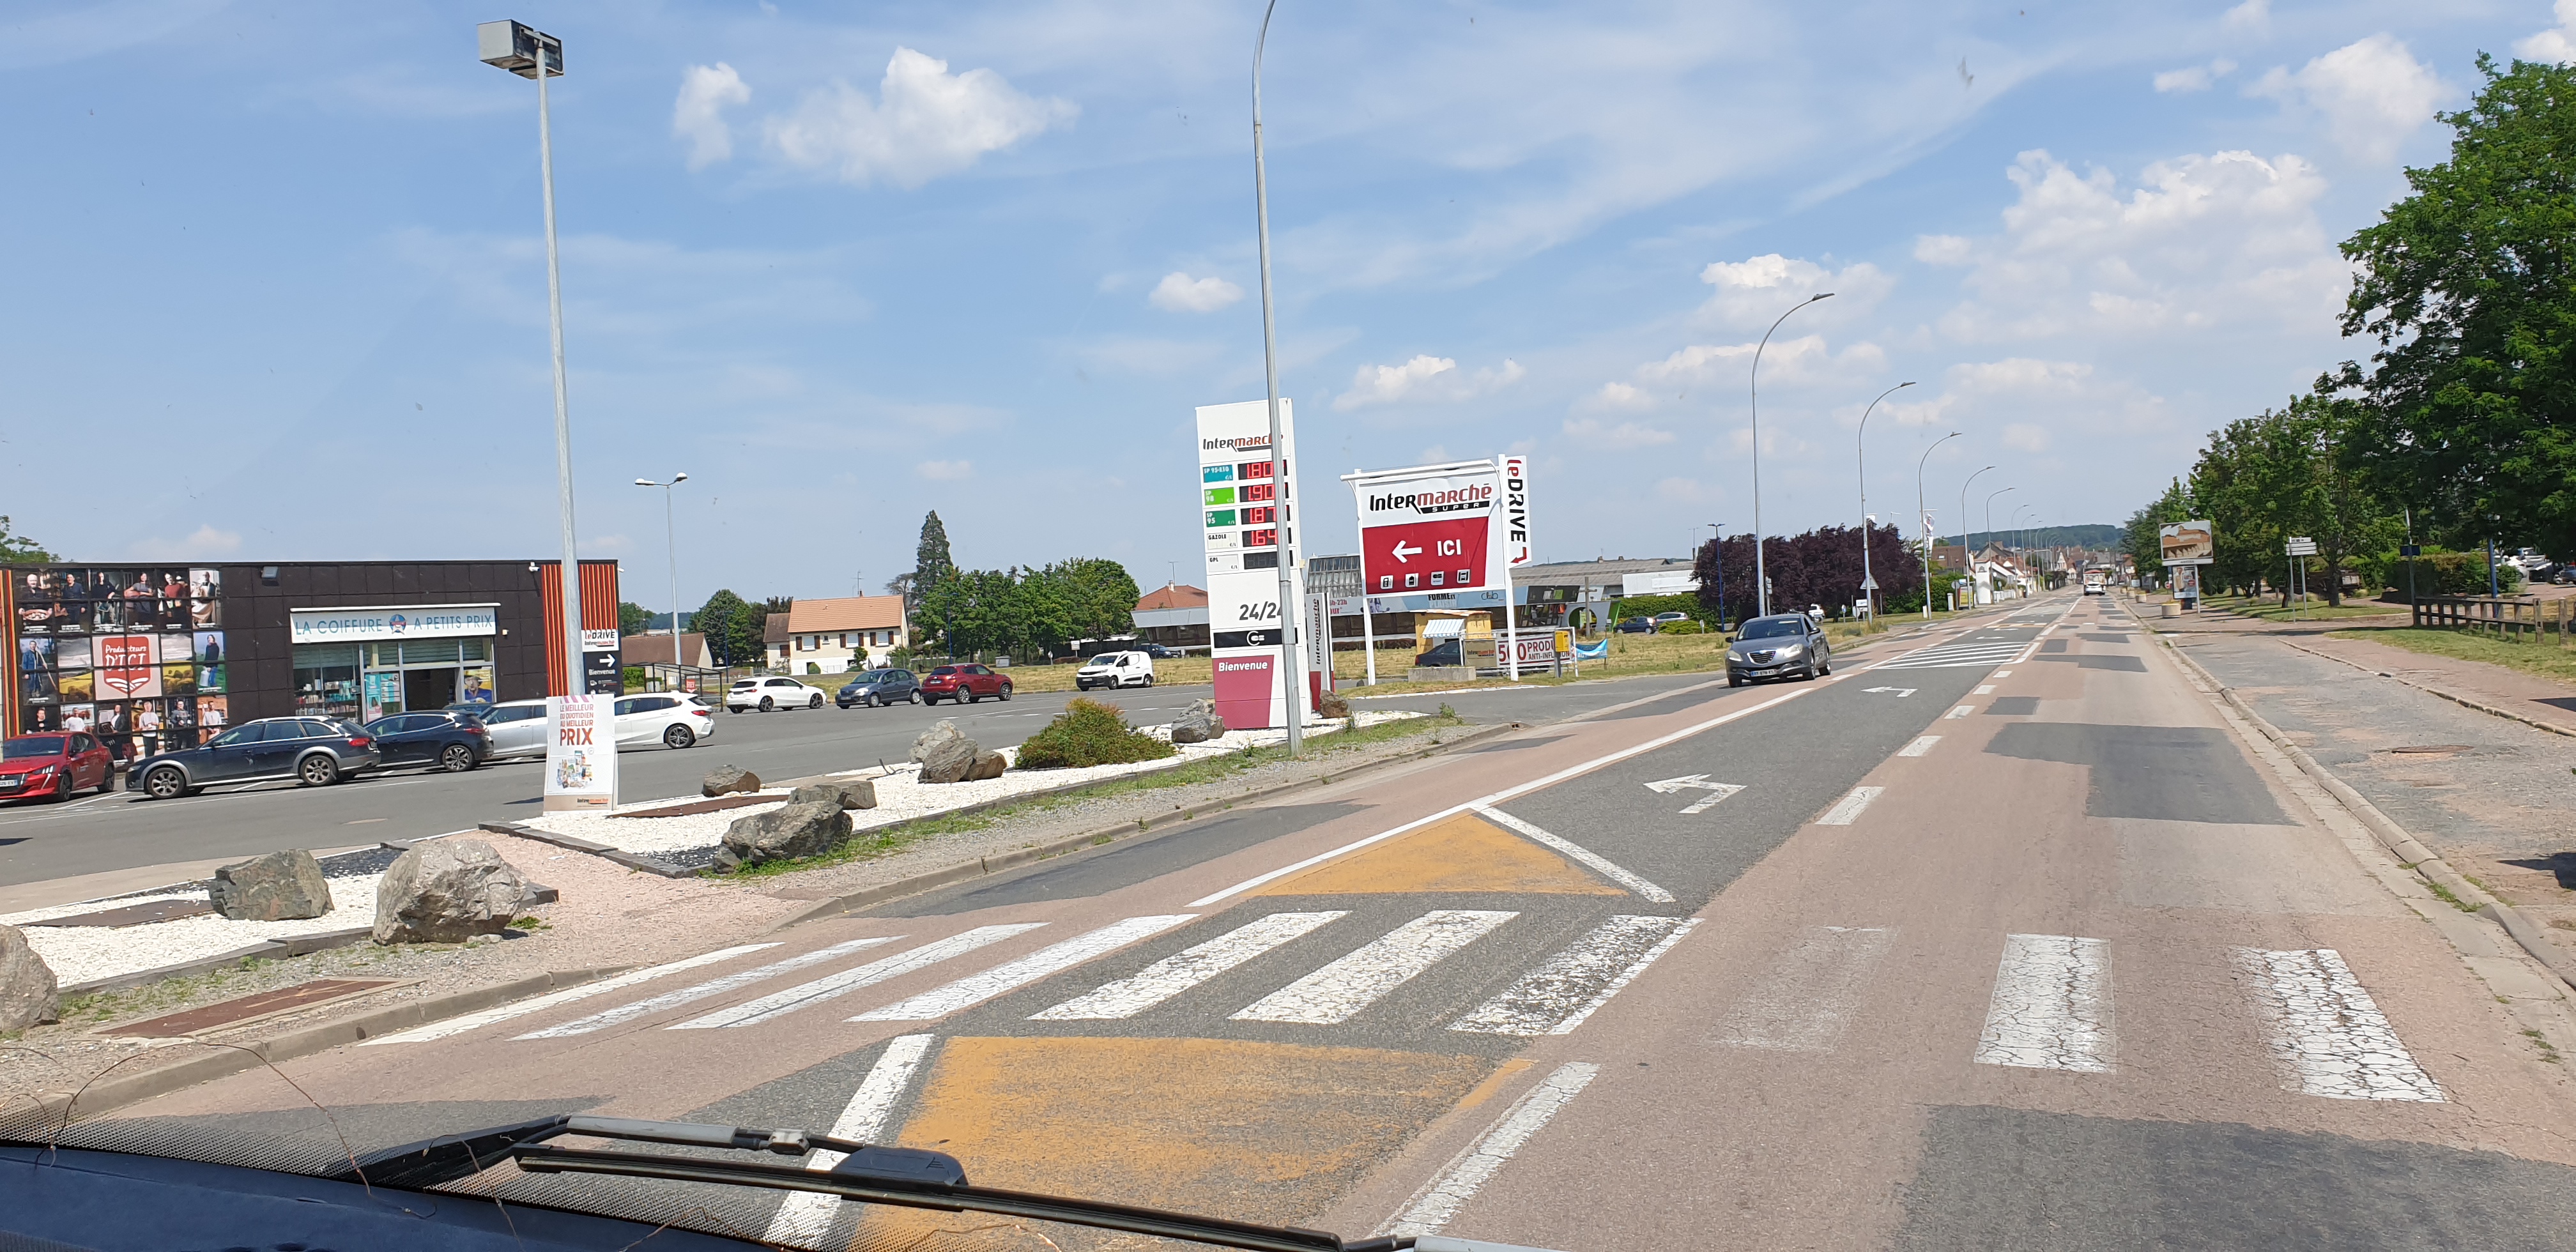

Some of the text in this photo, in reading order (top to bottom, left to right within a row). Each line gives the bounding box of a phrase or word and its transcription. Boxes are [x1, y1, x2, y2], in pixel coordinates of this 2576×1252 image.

[1203, 432, 1284, 452] Intermarc
[1370, 484, 1492, 514] Intermarché
[1437, 539, 1461, 556] ICI
[296, 618, 382, 635] LA COIFFURE
[414, 615, 492, 630] A PETITS PRIX
[1498, 643, 1526, 662] 50
[1528, 650, 1570, 660] ANTI-INFLION
[105, 653, 146, 671] D'ICI
[1218, 662, 1268, 671] Bienvenue
[560, 728, 593, 746] PRIX
